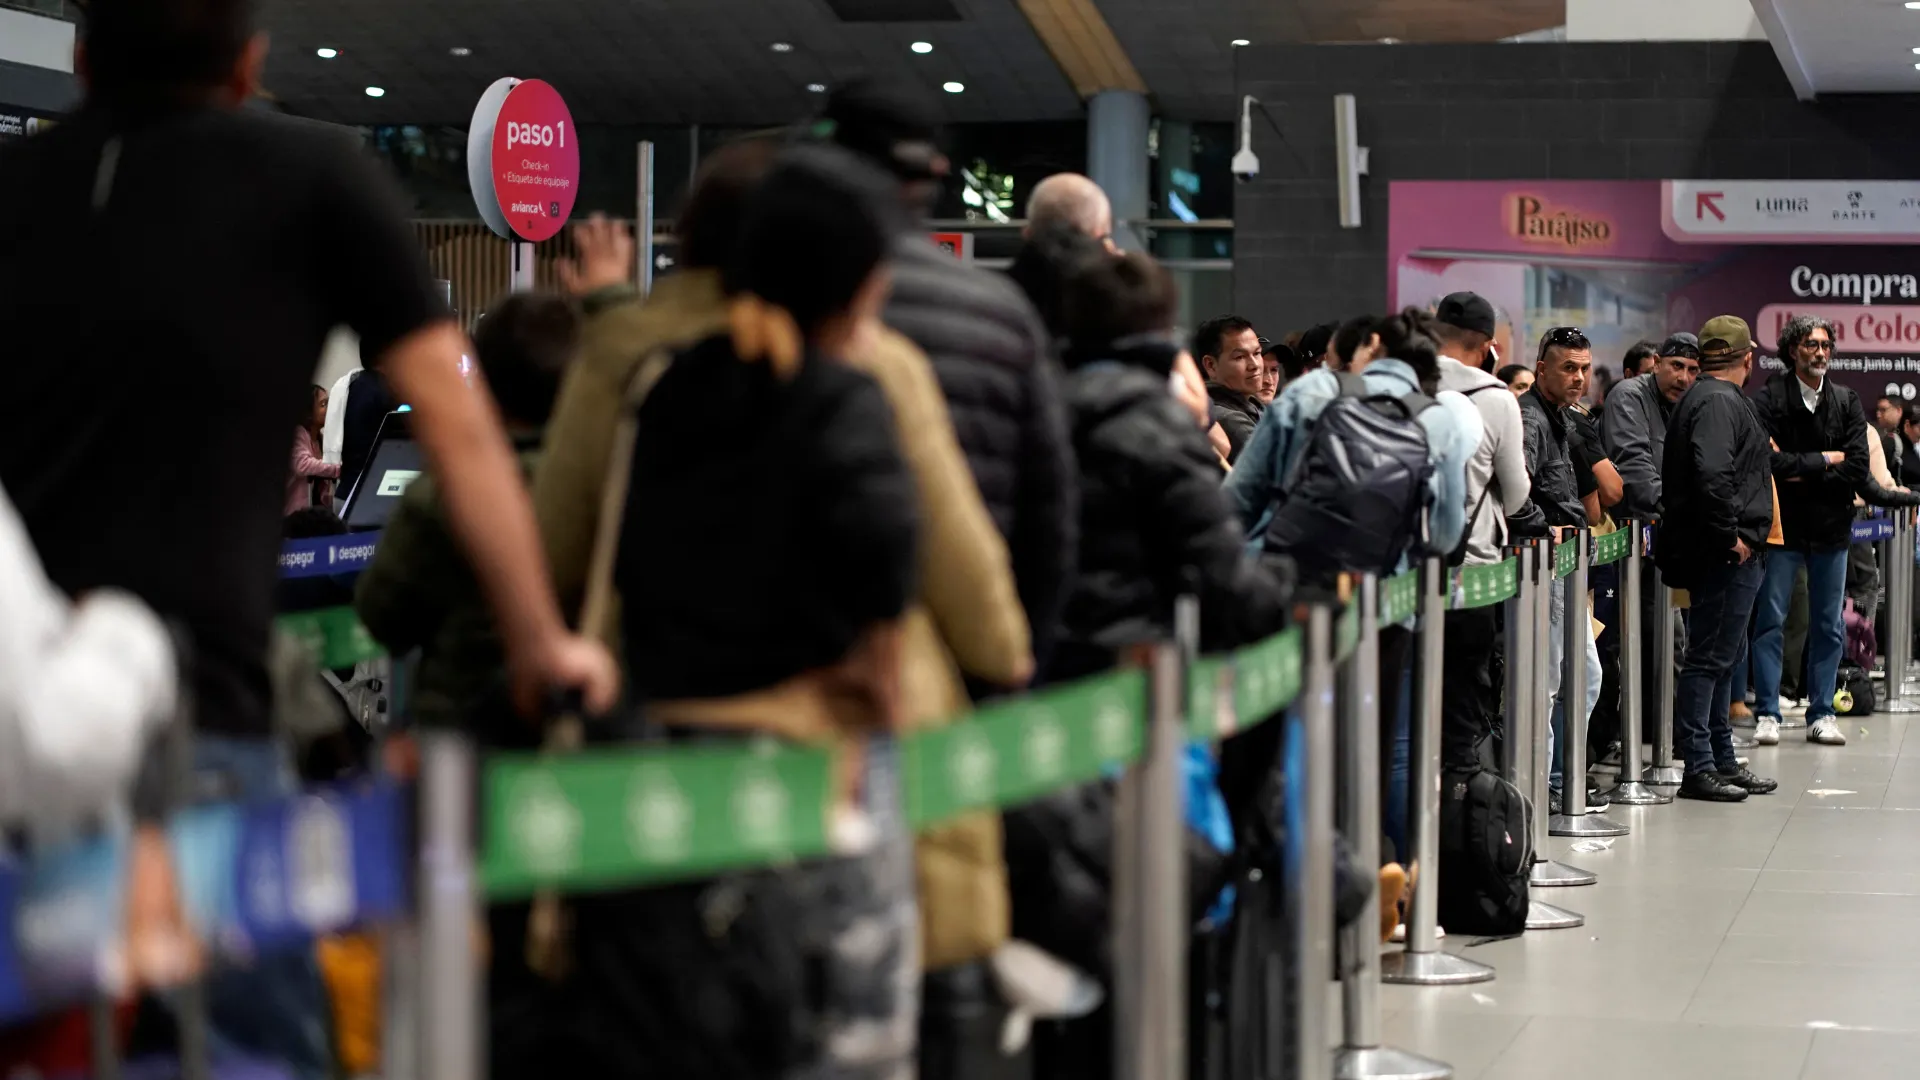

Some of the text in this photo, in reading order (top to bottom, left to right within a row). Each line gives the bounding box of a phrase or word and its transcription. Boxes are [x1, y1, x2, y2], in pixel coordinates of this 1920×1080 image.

[507, 120, 564, 150] paso 1
[521, 159, 549, 171] Check-in
[507, 171, 533, 184] Etiqueta
[534, 175, 542, 185] de
[543, 177, 570, 190] equipaje
[511, 201, 539, 214] avianca
[1832, 210, 1876, 220] DANTE
[1790, 265, 1918, 306] Compra
[1863, 356, 1893, 373] junto
[1894, 356, 1905, 371] al
[339, 544, 375, 561] despegar
